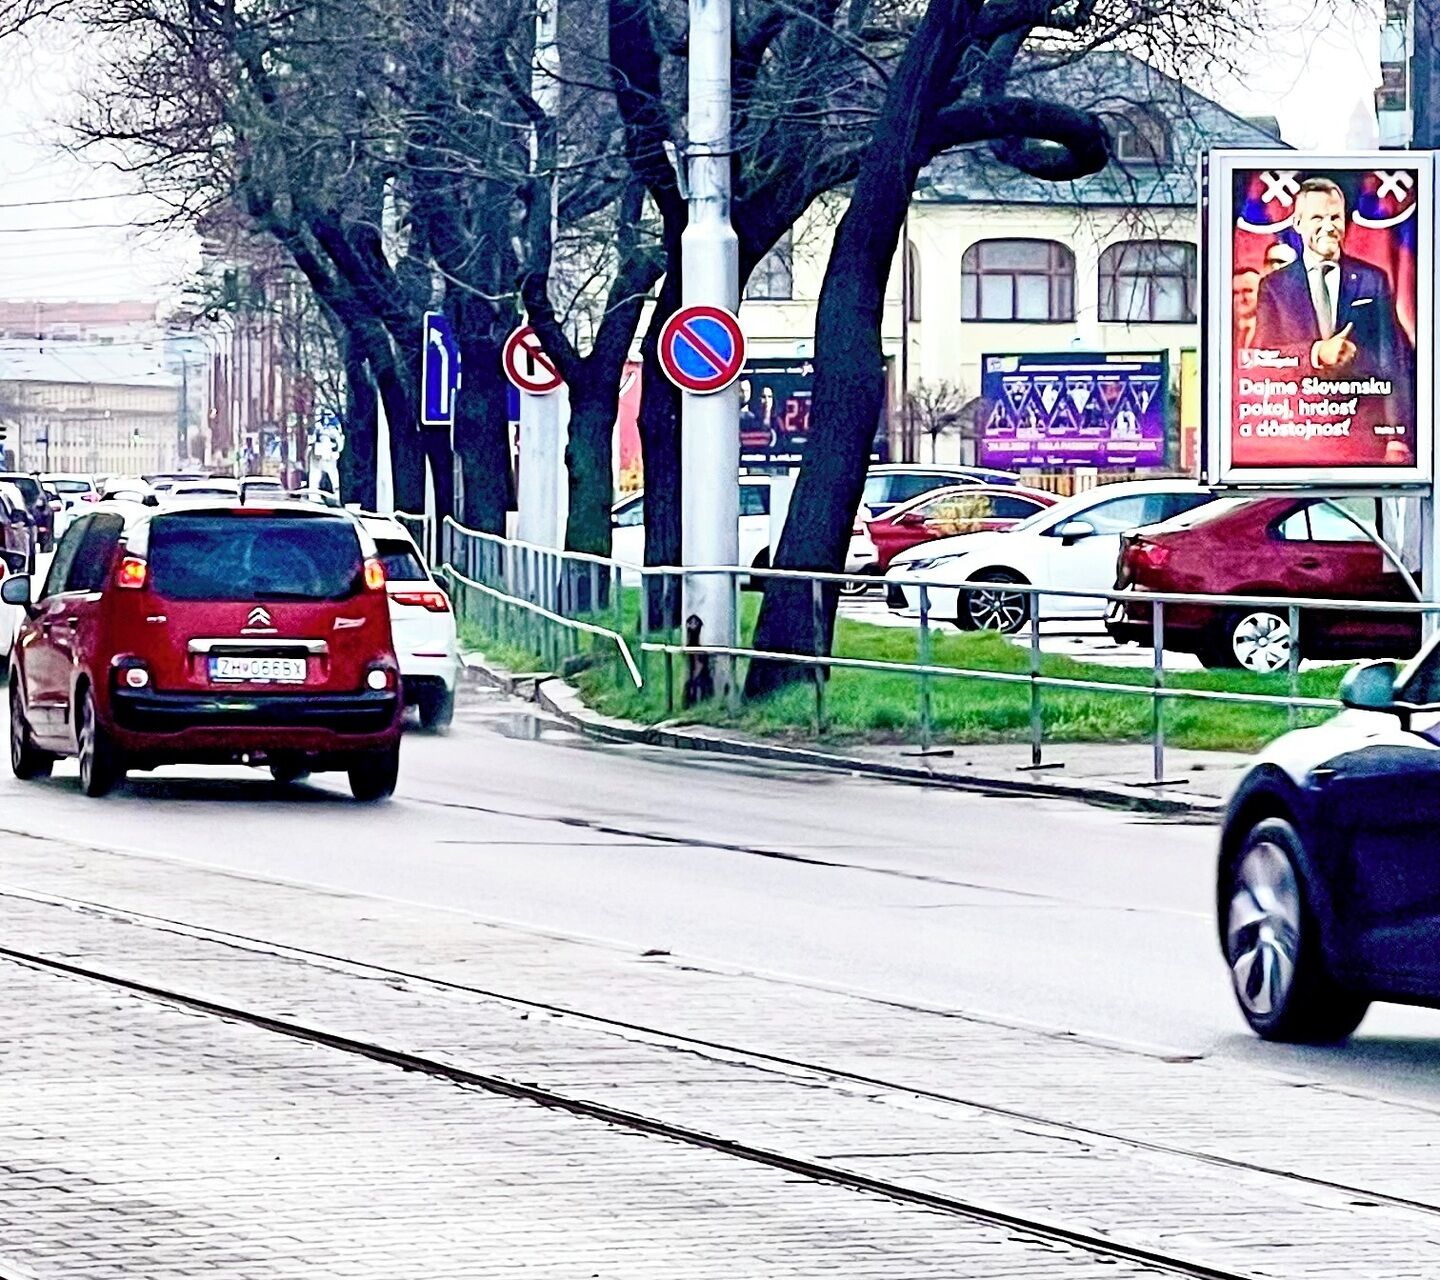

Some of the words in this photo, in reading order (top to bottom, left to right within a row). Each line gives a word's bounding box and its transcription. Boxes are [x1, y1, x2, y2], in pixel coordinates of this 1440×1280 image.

[1238, 377, 1298, 398] Dajme
[1301, 376, 1392, 395] Slovensku
[1239, 400, 1294, 419] pokoj,
[1298, 398, 1358, 416] hrdosť
[1239, 424, 1252, 436] a
[1256, 418, 1351, 438] dôstojnosť
